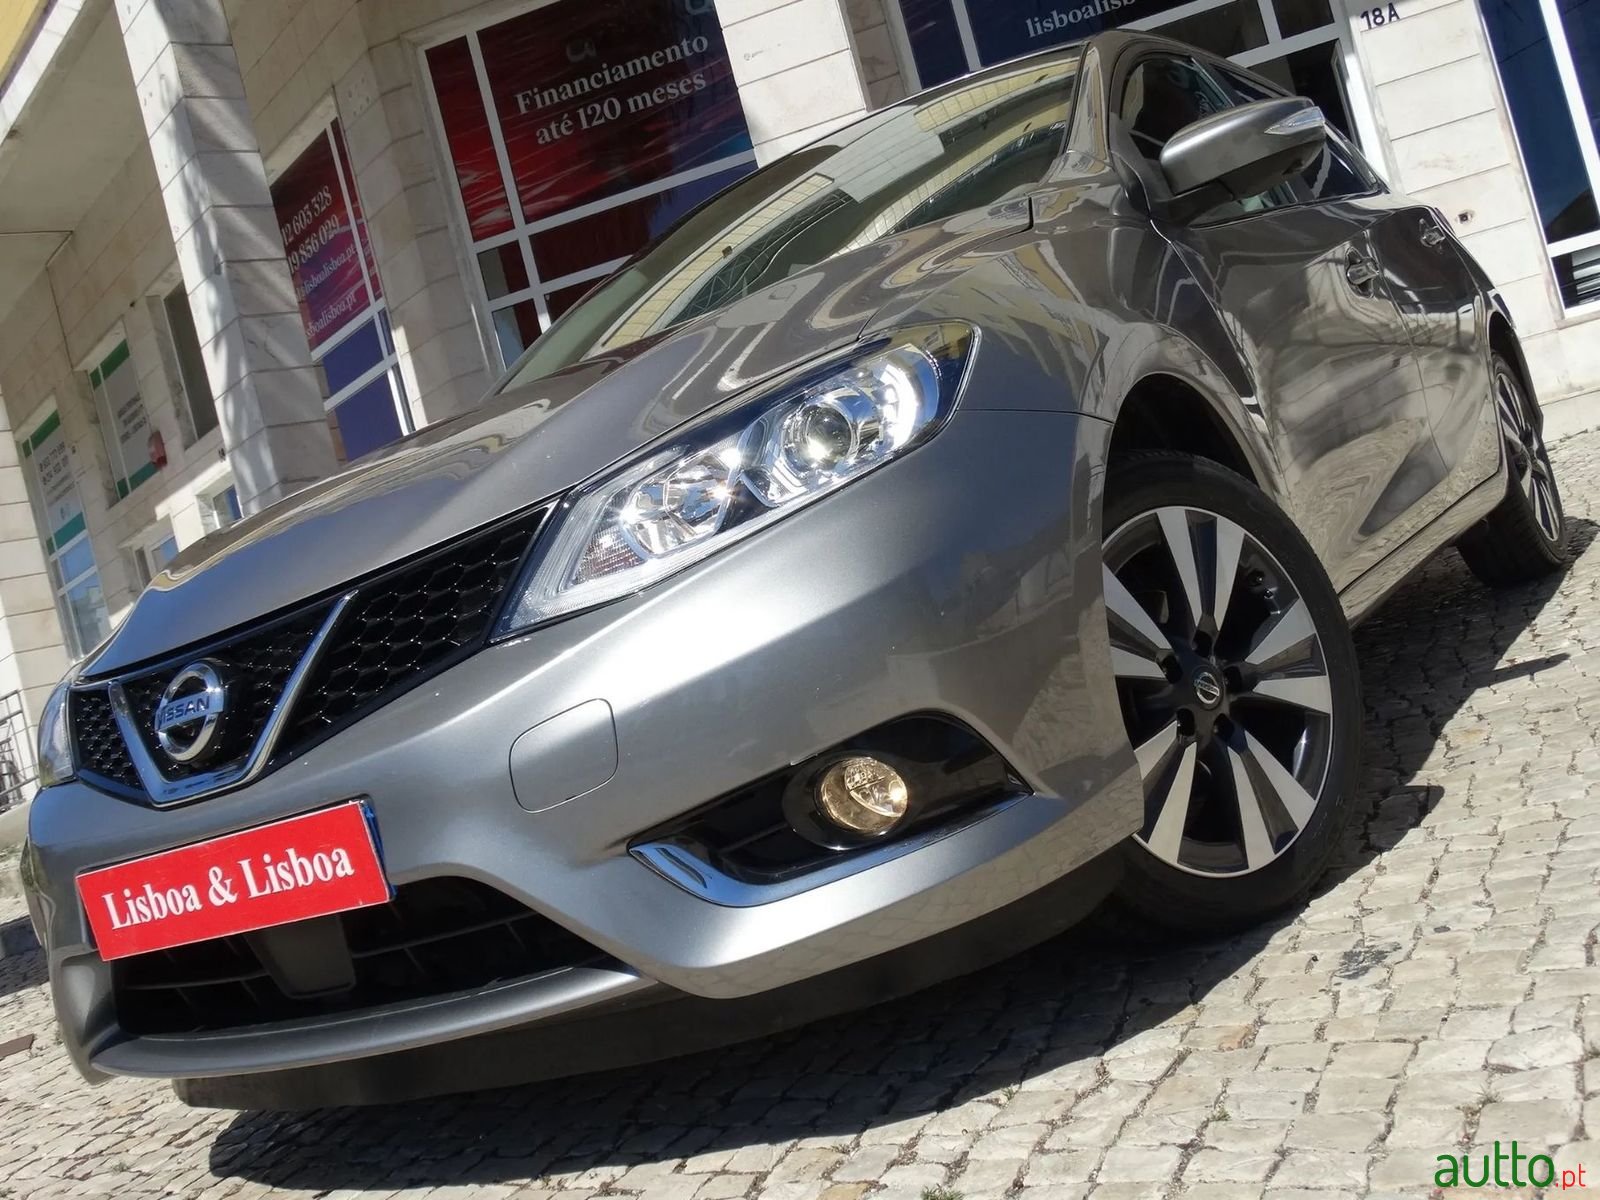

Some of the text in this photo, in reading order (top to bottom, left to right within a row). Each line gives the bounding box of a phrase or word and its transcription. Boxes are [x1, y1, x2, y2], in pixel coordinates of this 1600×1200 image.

[1361, 2, 1400, 30] 18A
[515, 35, 709, 116] Financiamento
[536, 72, 707, 145] até 120 meses
[299, 232, 320, 264] 856
[157, 695, 210, 729] NISSAN
[102, 847, 355, 930] Lisboa & Lisboa
